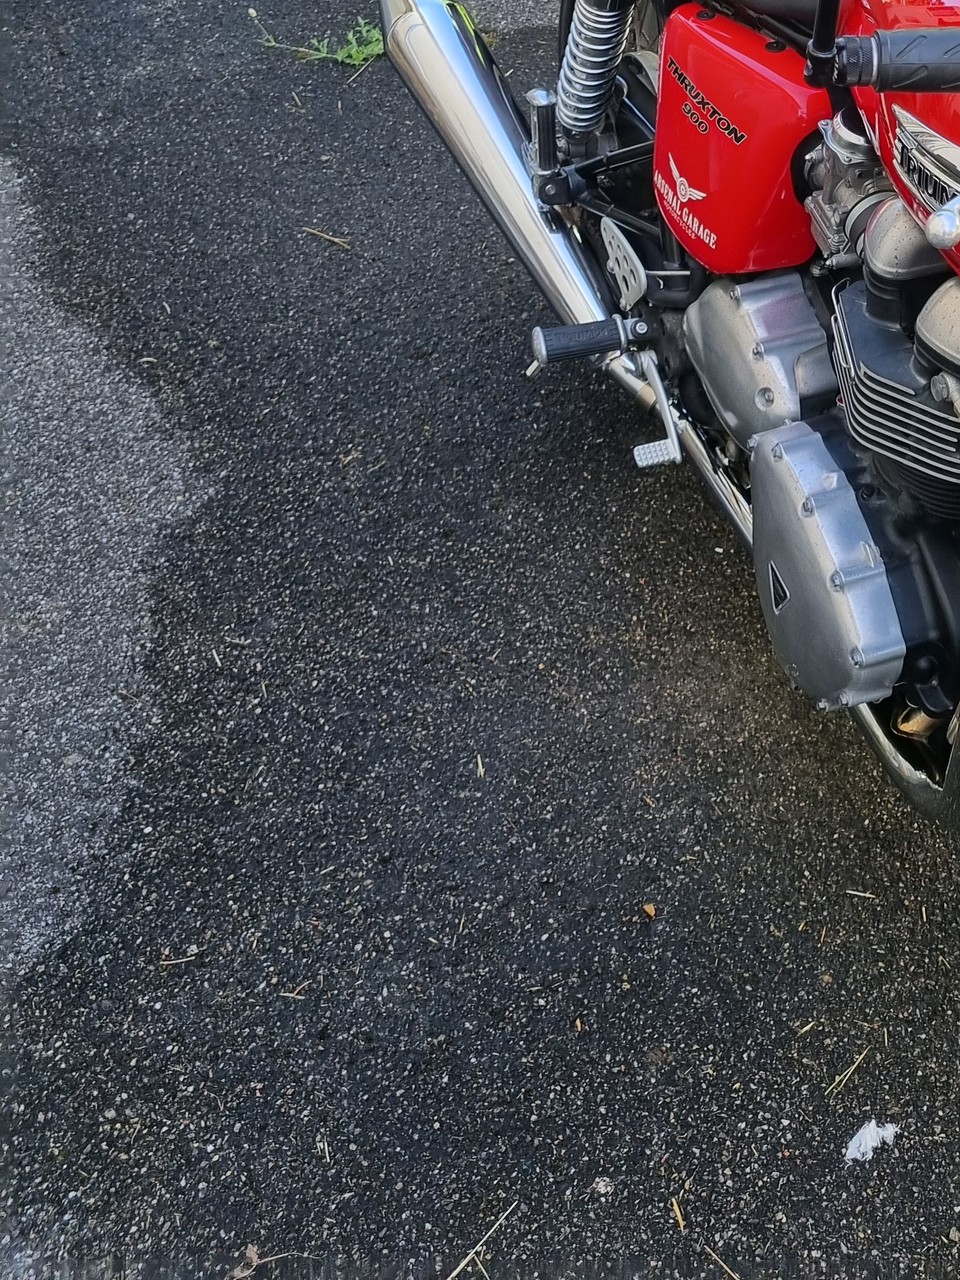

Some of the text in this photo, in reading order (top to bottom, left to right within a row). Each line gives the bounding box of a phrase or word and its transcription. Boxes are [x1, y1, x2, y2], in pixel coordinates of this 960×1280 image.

[667, 55, 747, 145] THRUXTON
[682, 102, 709, 134] 900
[654, 170, 717, 249] ARSENAL GARAGE
